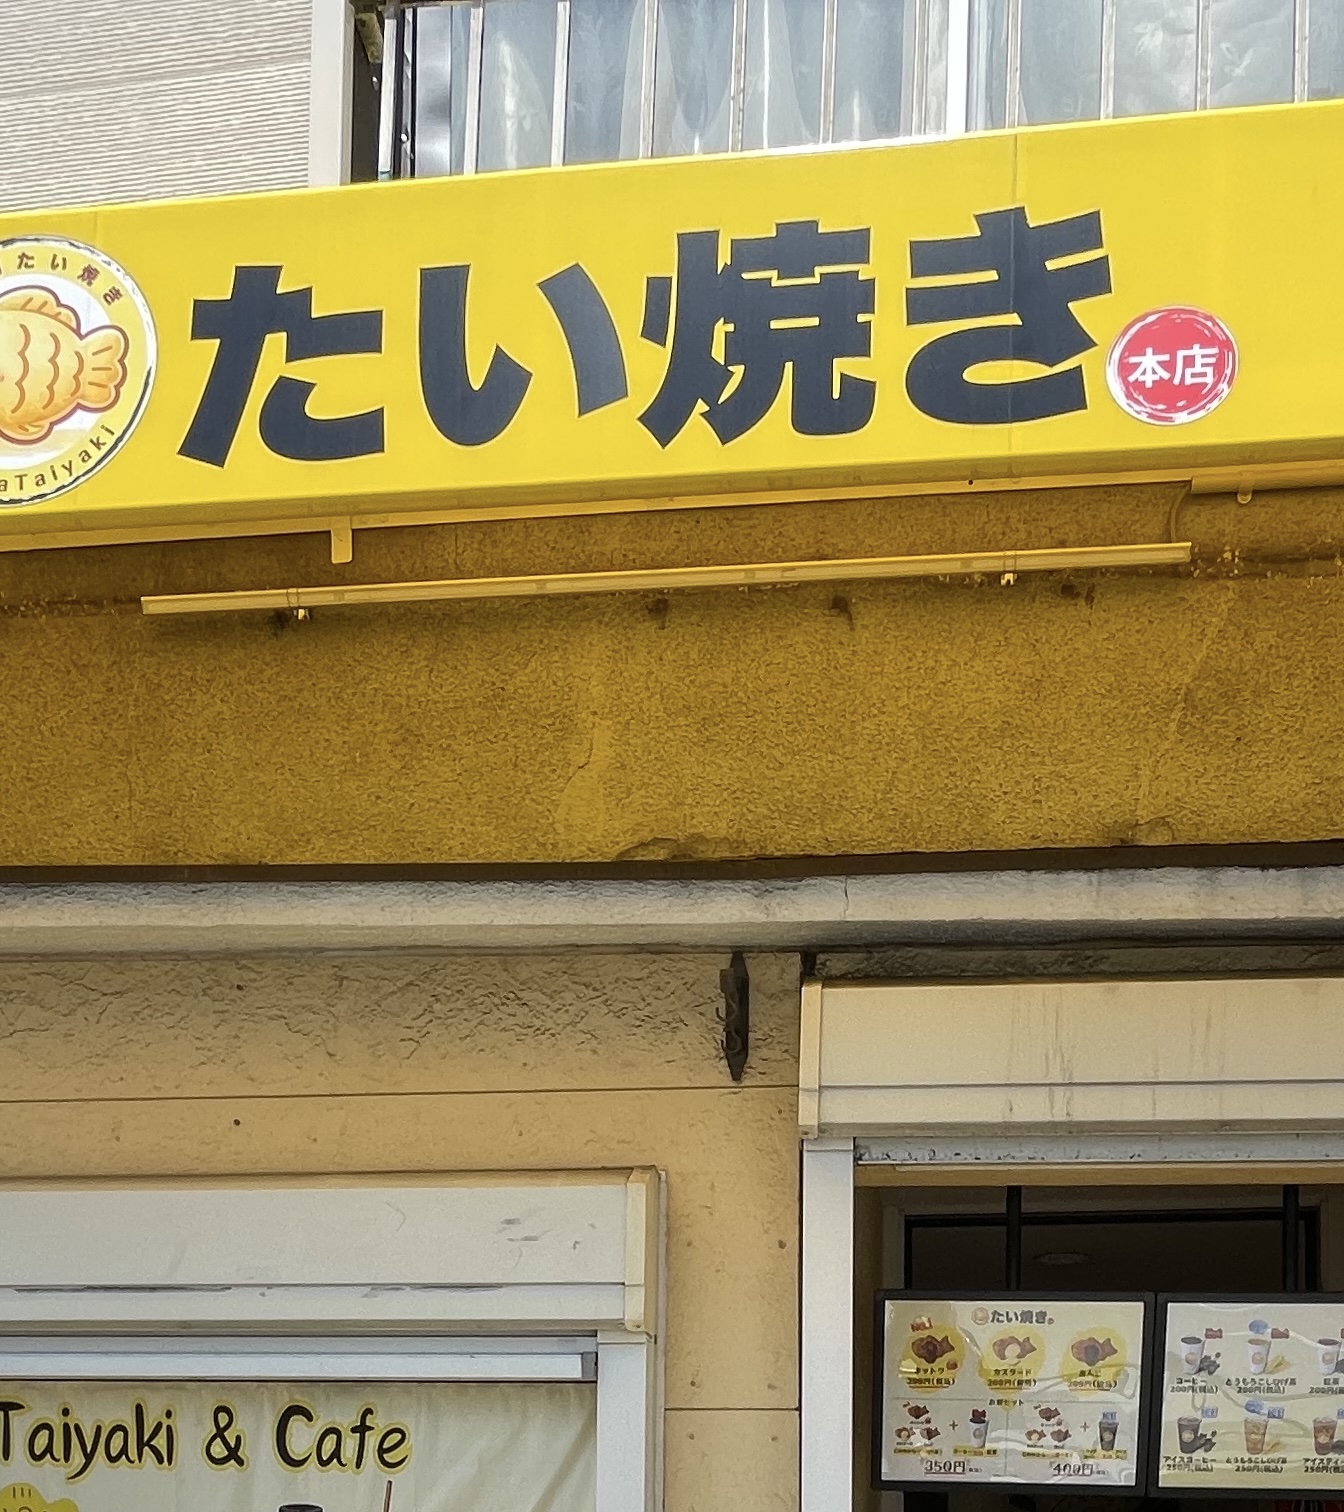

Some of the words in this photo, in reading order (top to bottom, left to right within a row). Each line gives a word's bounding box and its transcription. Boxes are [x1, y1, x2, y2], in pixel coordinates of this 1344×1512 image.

[178, 208, 1112, 468] たい焼き
[1127, 343, 1219, 395] 本店
[205, 1404, 245, 1468] &
[276, 1404, 409, 1470] Cafe
